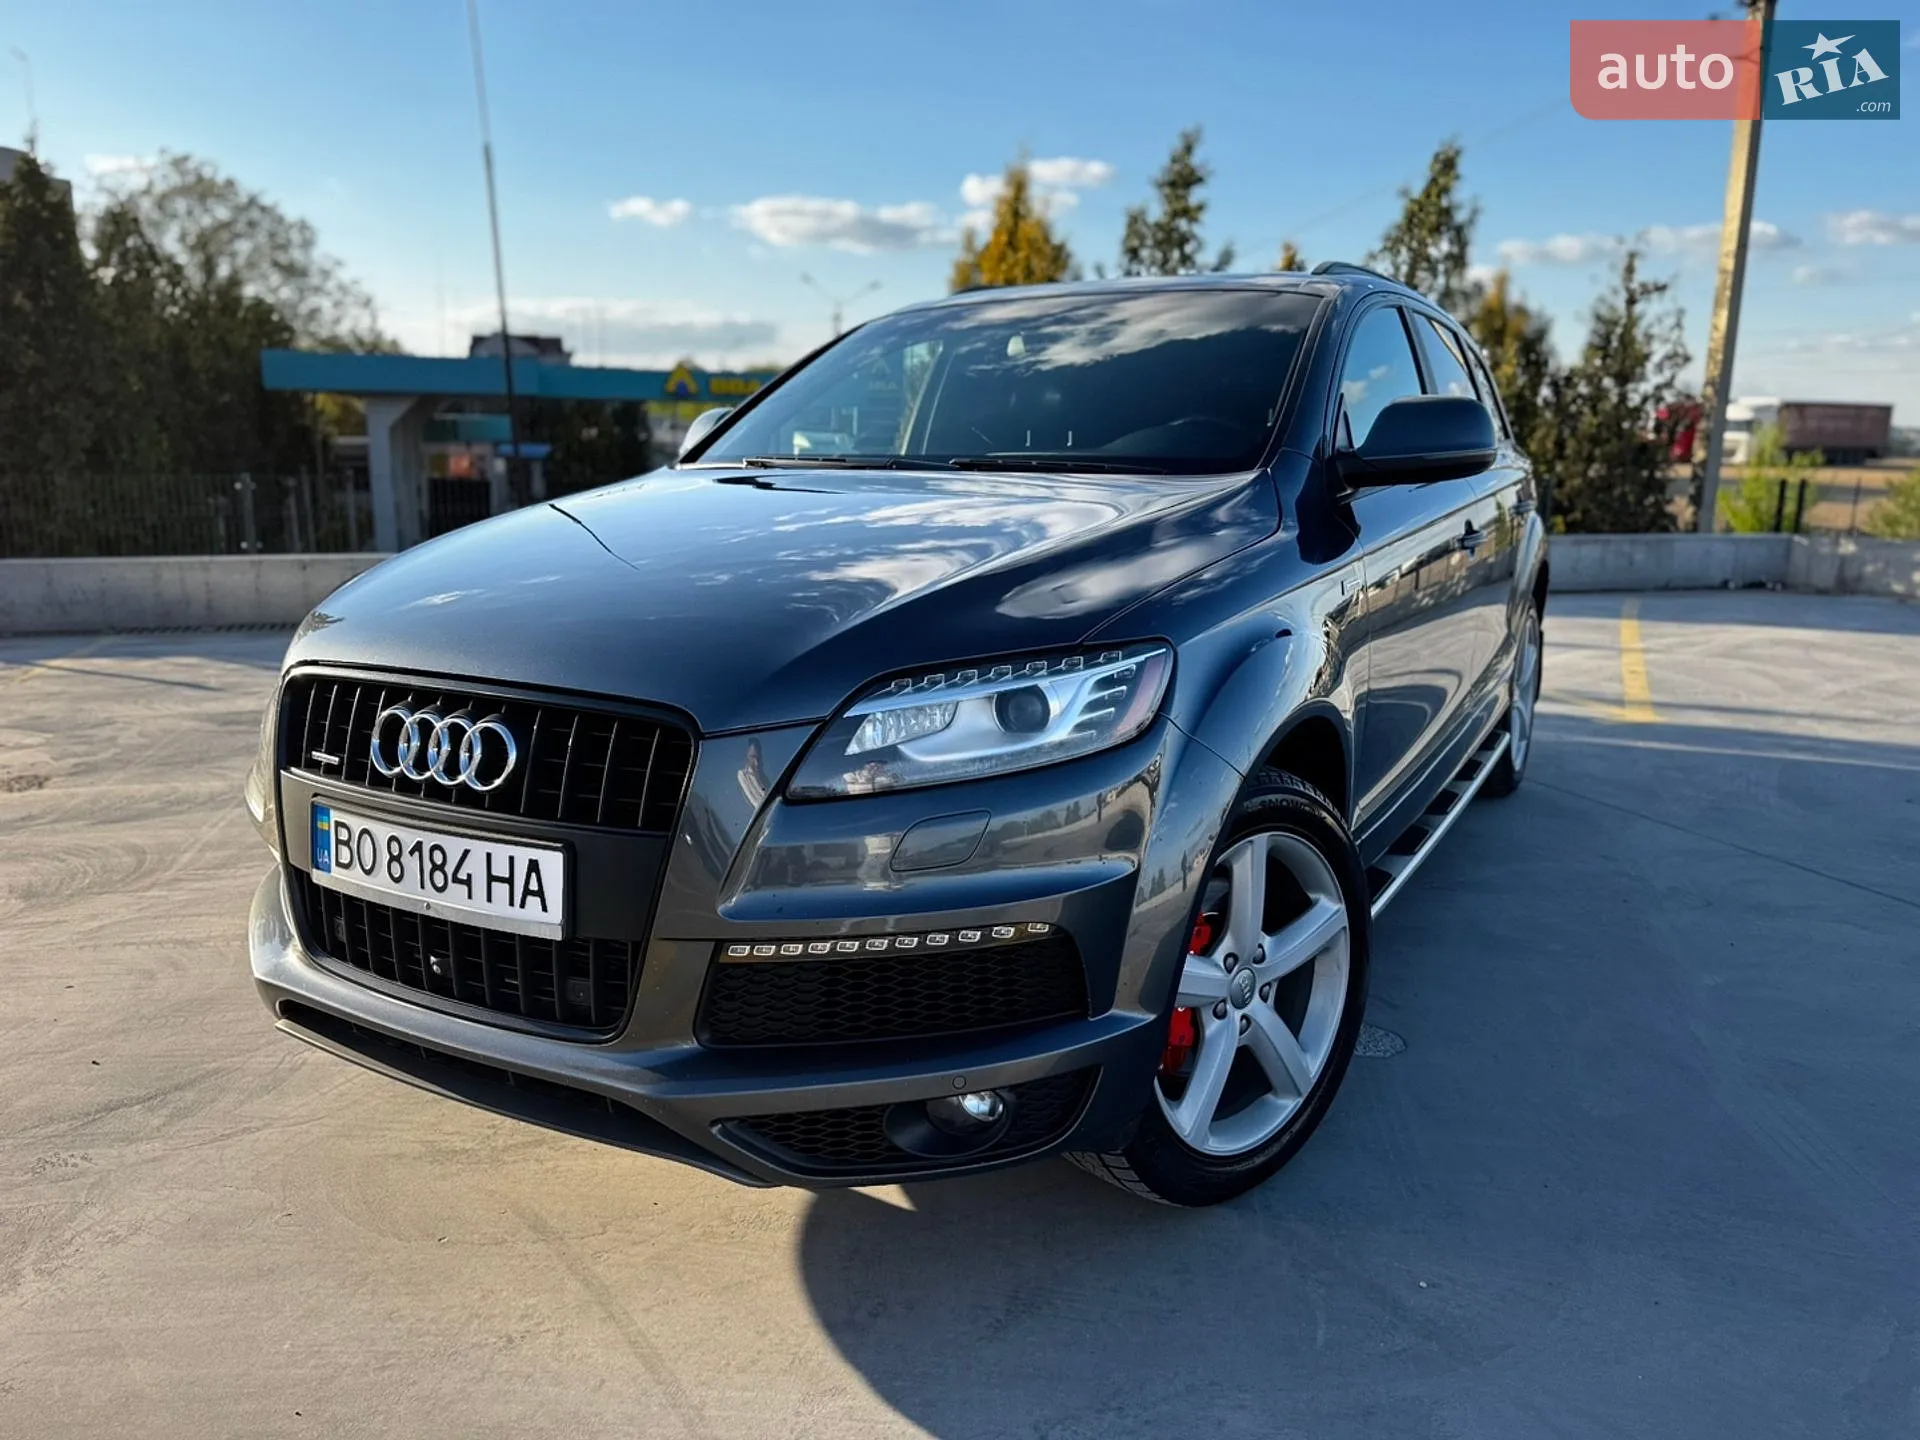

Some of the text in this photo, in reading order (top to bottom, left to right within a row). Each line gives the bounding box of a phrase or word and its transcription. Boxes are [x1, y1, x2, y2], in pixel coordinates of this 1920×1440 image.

[316, 847, 330, 865] UA
[334, 819, 549, 914] BO 8184 HA
